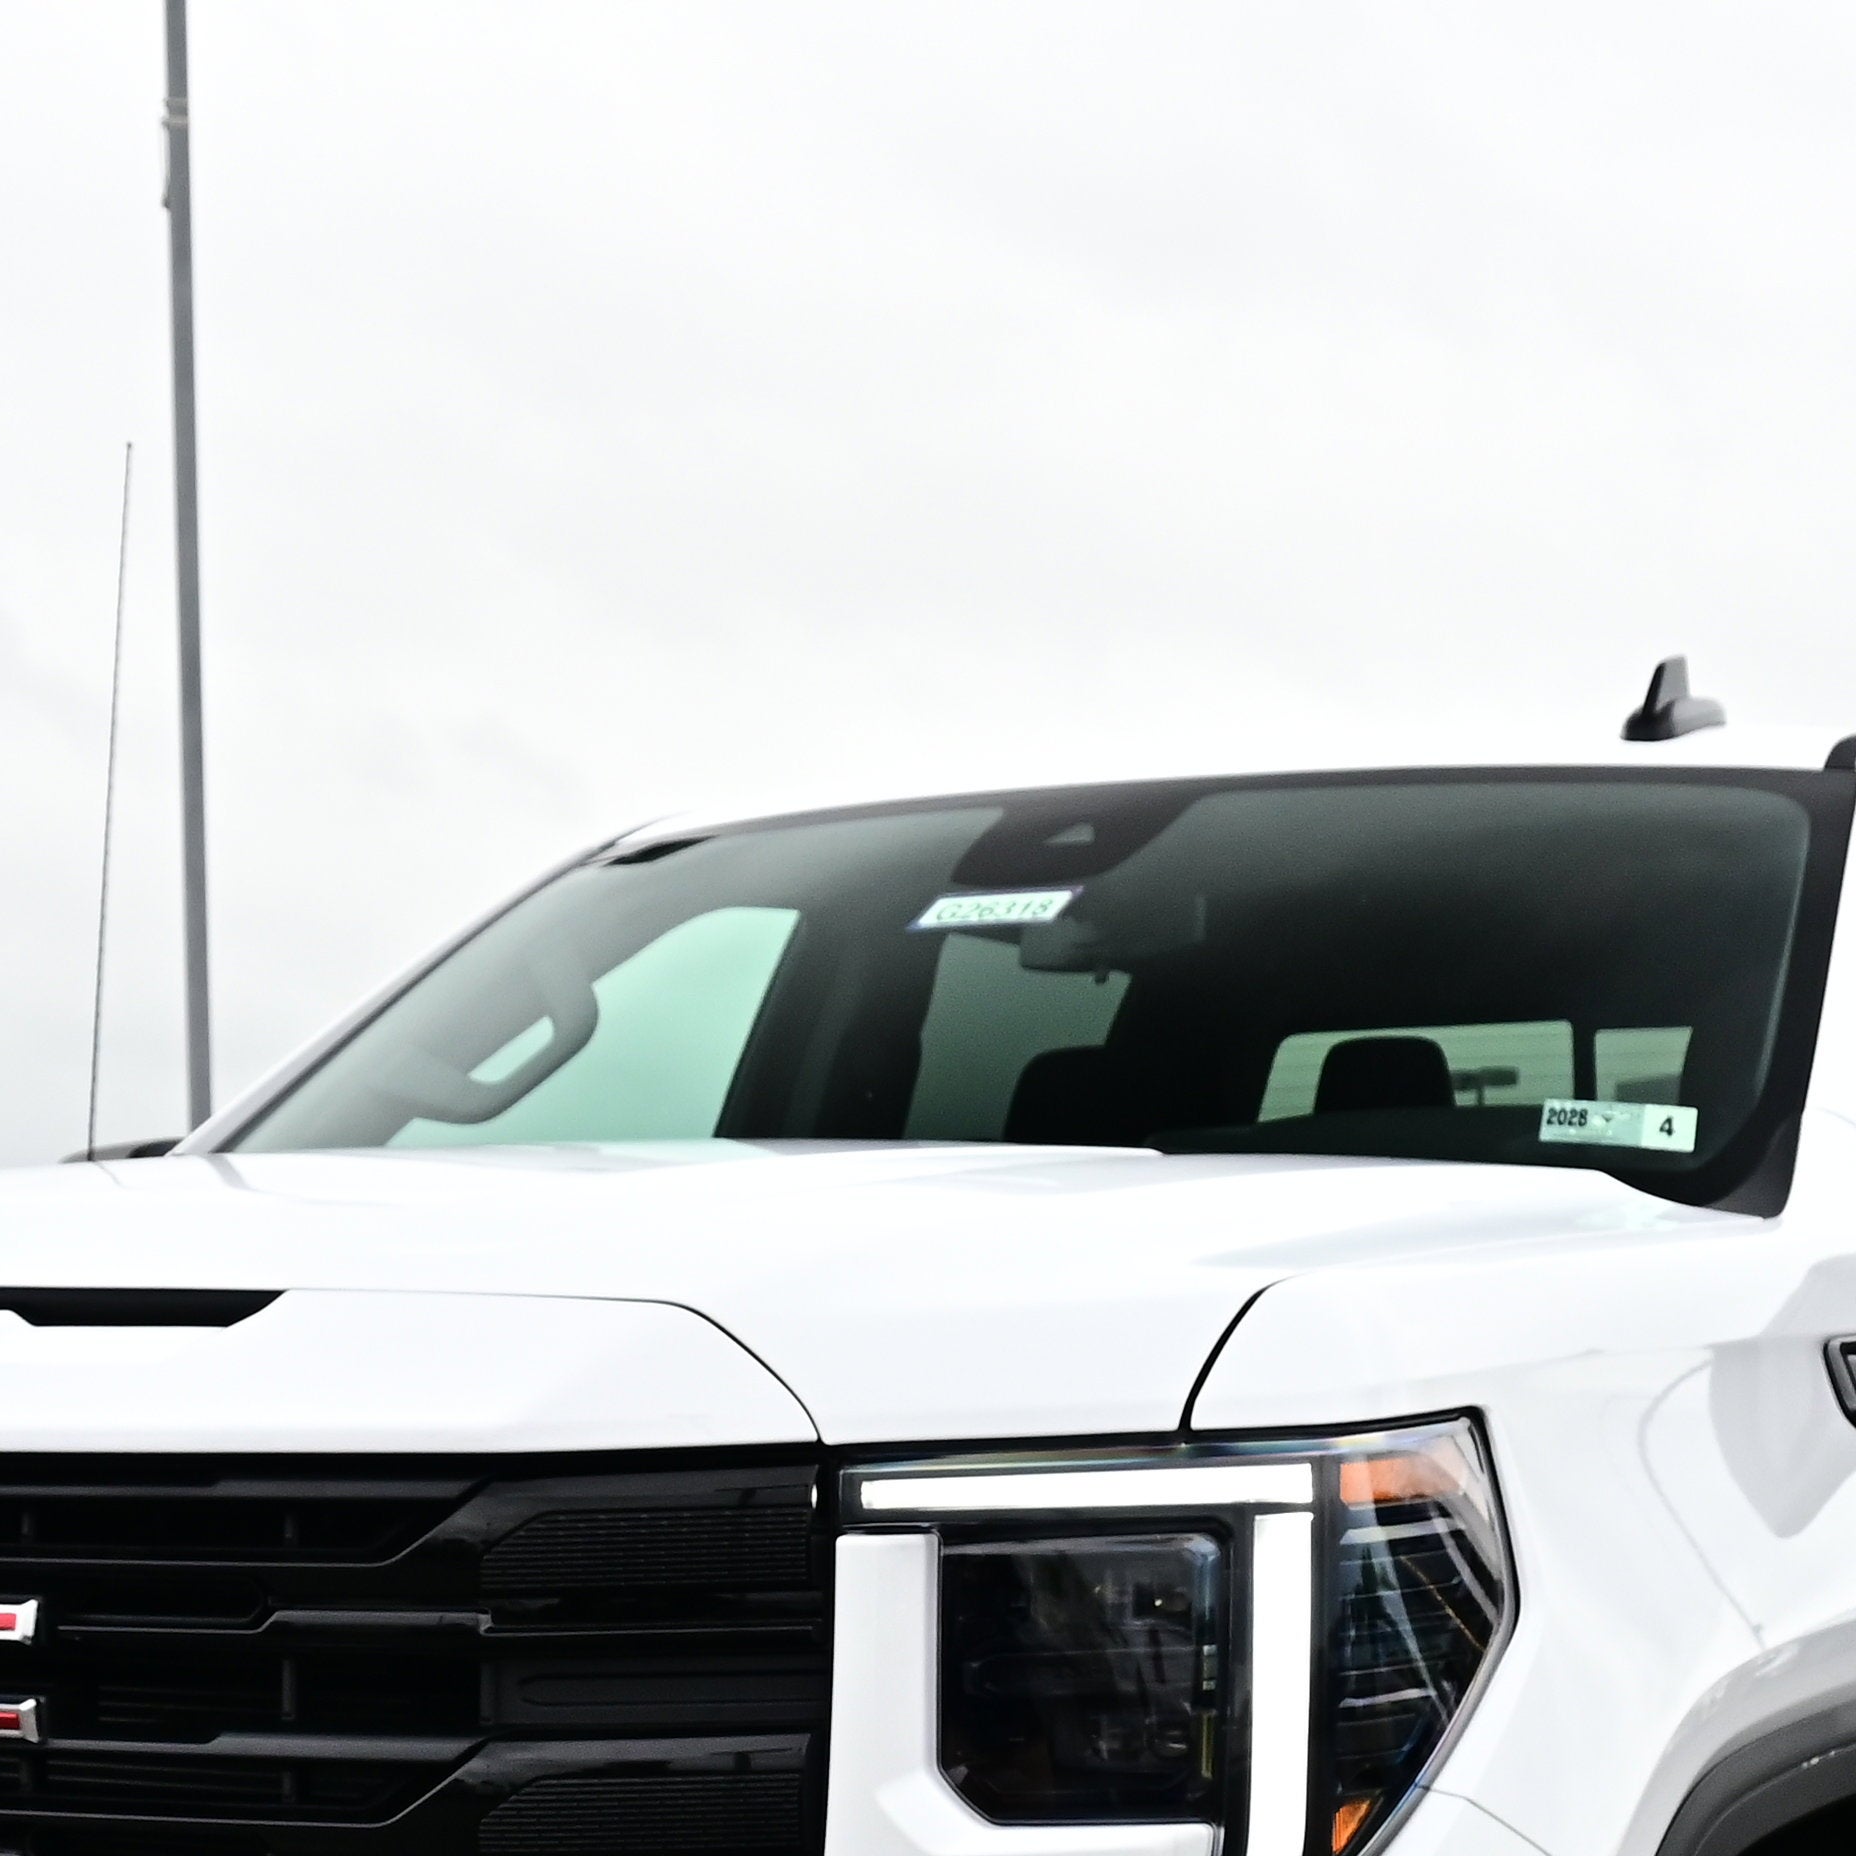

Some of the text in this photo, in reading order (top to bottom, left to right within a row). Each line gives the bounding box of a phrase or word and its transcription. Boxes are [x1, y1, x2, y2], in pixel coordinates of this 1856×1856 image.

[936, 900, 1053, 920] G26318
[1546, 1107, 1588, 1127] 2028
[1659, 1115, 1674, 1136] 4
